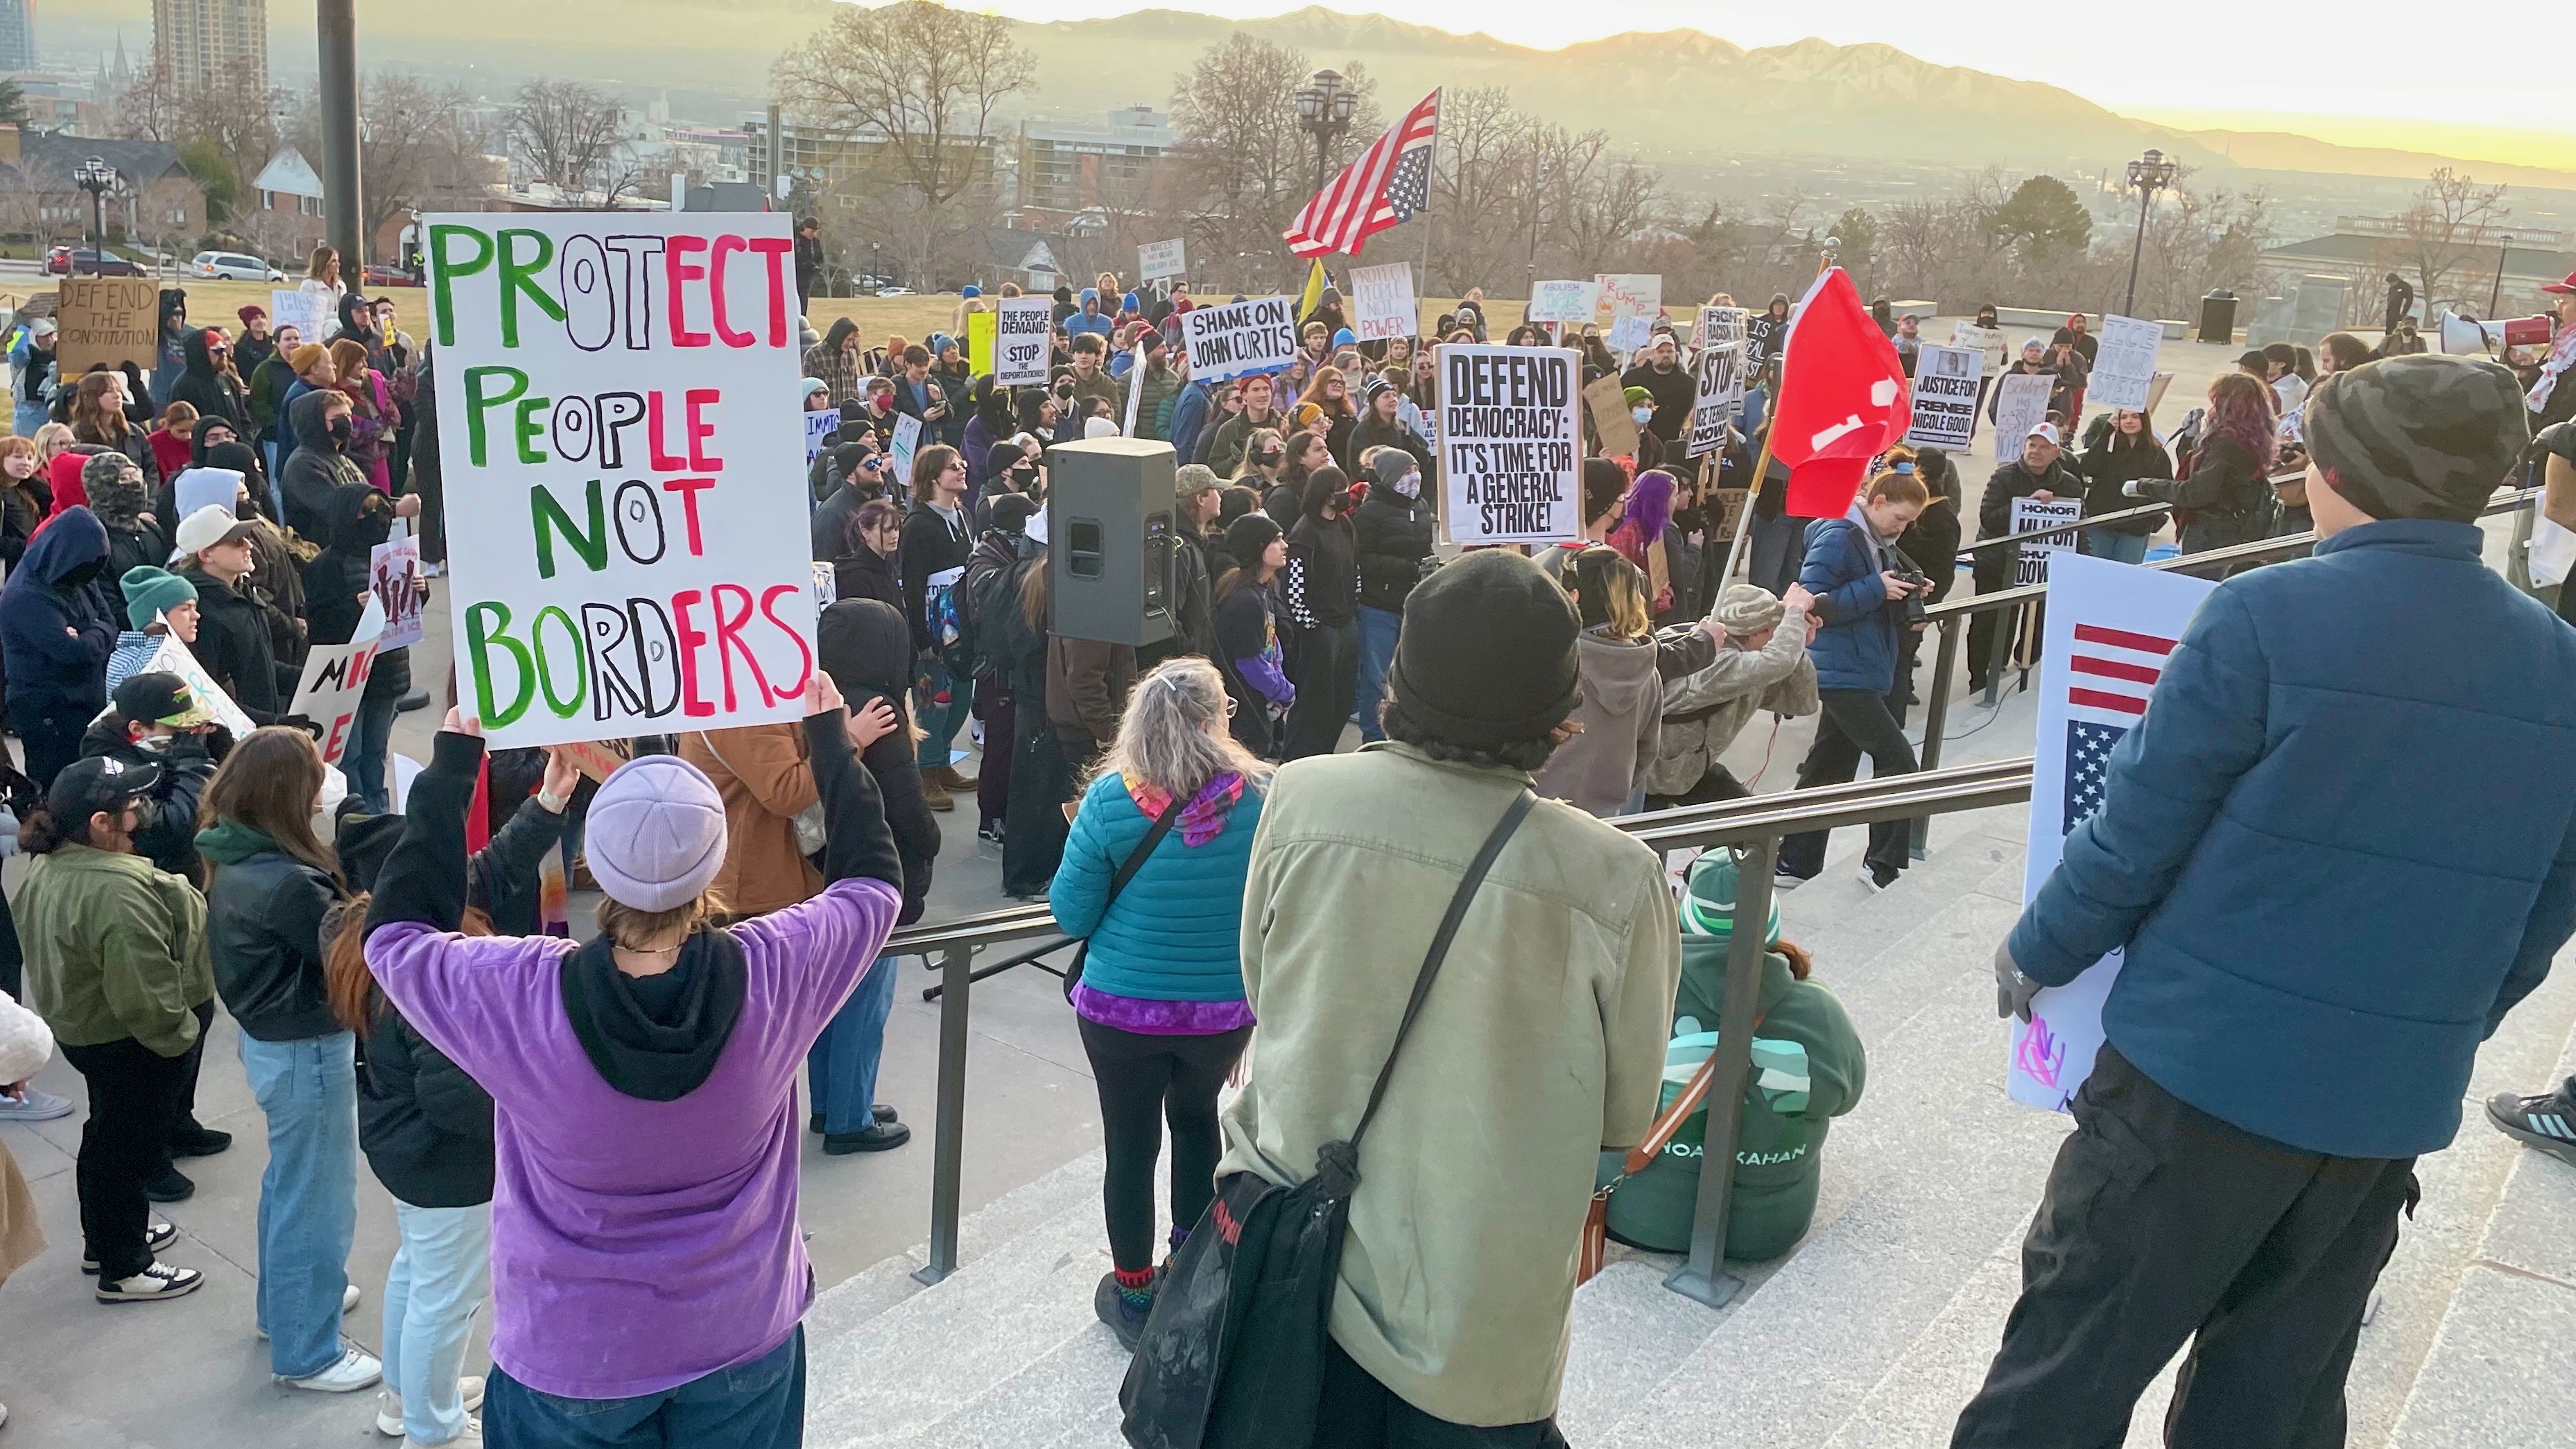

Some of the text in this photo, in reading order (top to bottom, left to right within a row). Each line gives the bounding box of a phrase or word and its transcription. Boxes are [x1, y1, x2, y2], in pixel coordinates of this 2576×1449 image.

[60, 284, 154, 310] DEFEND
[429, 224, 793, 352] PROTECT
[1359, 281, 1404, 302] PEOPLE
[1544, 283, 1580, 292] ABOLISH
[1002, 311, 1049, 322] THE PEOPLE
[1193, 300, 1285, 336] SHAME ON
[1367, 300, 1392, 316] NOT
[90, 312, 132, 328] THE
[1002, 321, 1048, 334] DEMAND:
[1362, 316, 1404, 338] POWER
[59, 328, 155, 347] CONSTITUTION
[2103, 319, 2160, 350] ICE
[1010, 344, 1039, 362] STOP
[1193, 325, 1294, 369] JOHN CURTIS
[1018, 363, 1029, 371] THE
[1449, 354, 1568, 408] DEFEND
[1918, 376, 1978, 398] JUSTICE FOR
[1695, 408, 1708, 428] ICE
[1915, 399, 1973, 415] RENEE
[464, 365, 723, 472] PEOPLE
[1448, 407, 1568, 439] DEMOCRACY:
[1912, 413, 1971, 433] NICOLE GOOD
[1996, 435, 2010, 458] NO
[1452, 442, 1573, 474] IT'S TIME FOR
[1467, 472, 1563, 504] A GENERAL
[1481, 503, 1551, 535] STRIKE!
[2021, 504, 2076, 516] HONOR
[530, 478, 716, 579] NOT
[465, 584, 812, 730] BORDERS
